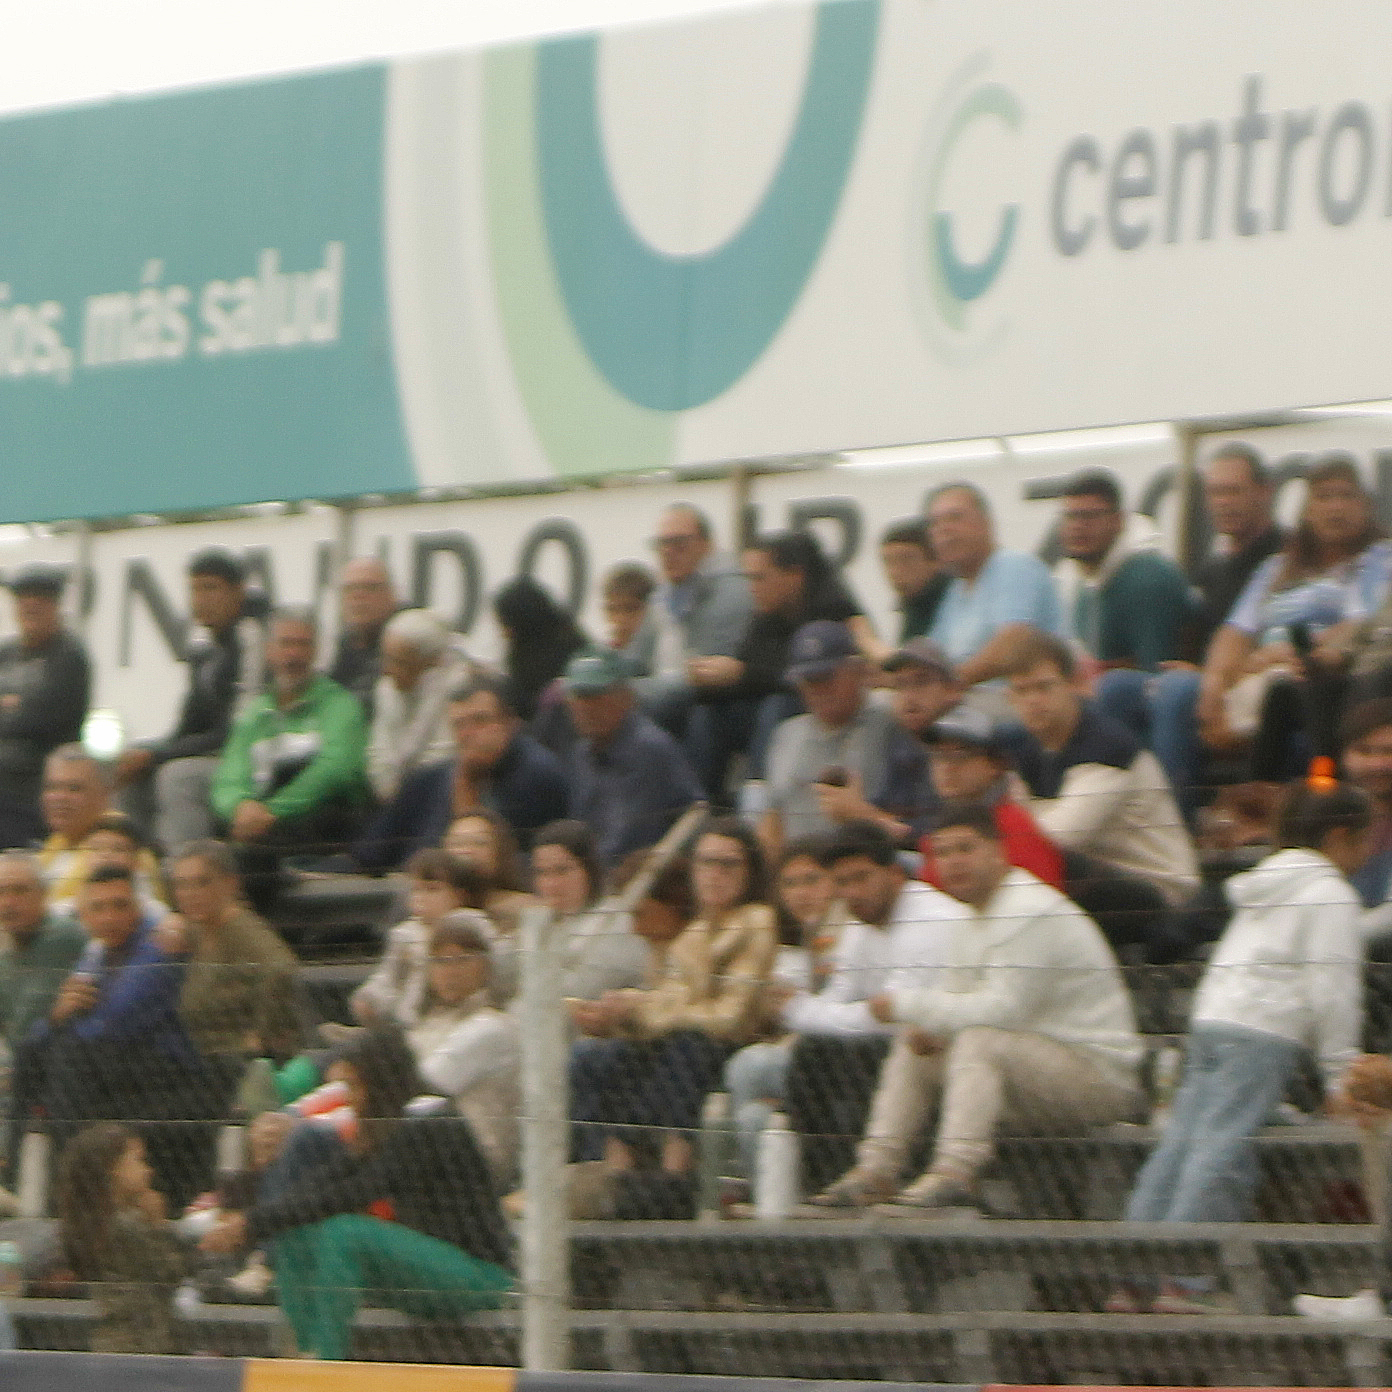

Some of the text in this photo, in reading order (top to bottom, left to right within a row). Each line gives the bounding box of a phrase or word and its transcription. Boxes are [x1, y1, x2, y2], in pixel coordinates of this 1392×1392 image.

[1052, 70, 1392, 257] centro
[82, 256, 191, 367] más
[198, 240, 345, 355] salud
